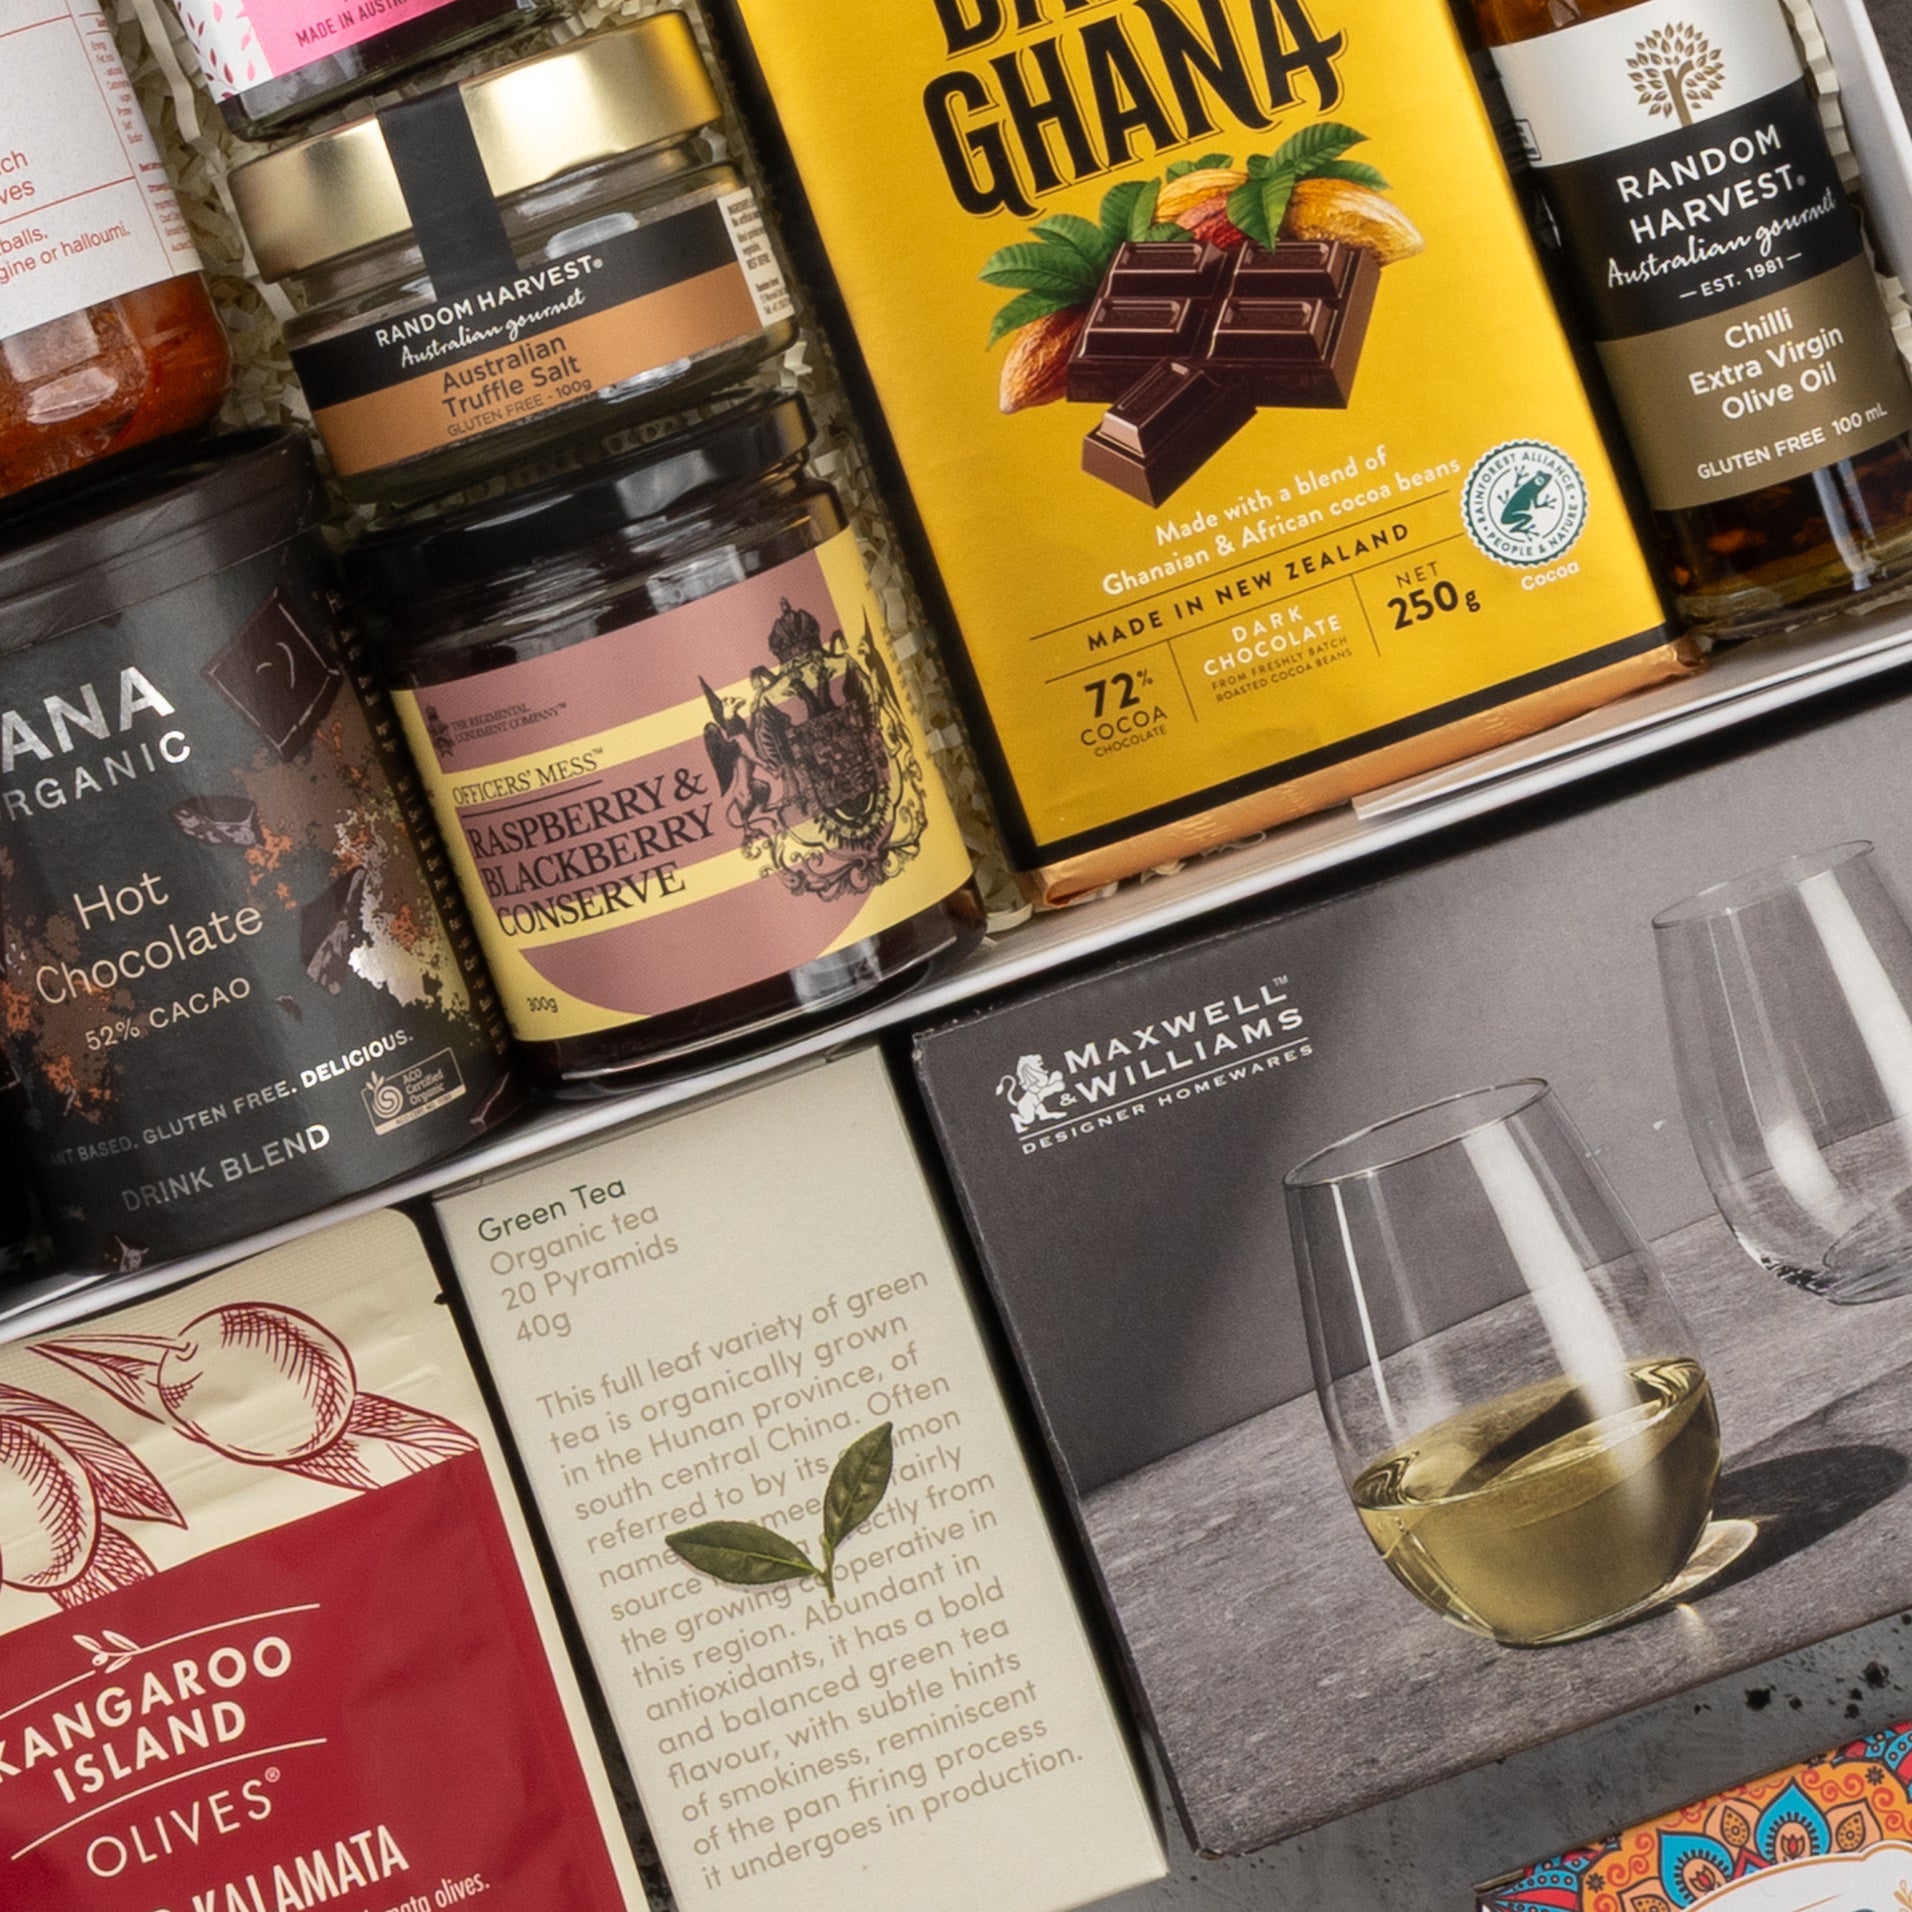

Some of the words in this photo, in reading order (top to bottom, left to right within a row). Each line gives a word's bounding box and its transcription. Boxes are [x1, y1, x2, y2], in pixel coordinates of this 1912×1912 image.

[296, 18, 337, 47] MADE
[338, 11, 355, 29] IN
[922, 0, 1348, 219] GHANA
[1617, 124, 1782, 203] RANDOM
[40, 248, 58, 265] or
[1607, 233, 1751, 289] Australian
[1755, 187, 1836, 257] gourmet
[375, 298, 474, 346] RANDOM
[400, 324, 503, 369] Australian
[505, 287, 586, 340] gourmet
[1689, 359, 1763, 396] Extra
[1766, 327, 1844, 368] Virgin
[1724, 307, 1793, 349] Chilli
[441, 371, 525, 418] Truffle
[530, 353, 581, 389] Salt
[442, 333, 567, 393] Australian
[1722, 382, 1794, 420] Olive
[1800, 361, 1838, 393] Oil
[446, 408, 503, 437] GLUTEN
[504, 393, 545, 421] FREE
[555, 377, 592, 401] 100g
[1697, 446, 1771, 480] GLUTEN
[1774, 427, 1826, 457] FREE
[1831, 411, 1863, 436] 100
[1865, 402, 1888, 423] mL
[1155, 511, 1218, 546] Made
[1224, 490, 1273, 521] with
[1279, 487, 1292, 502] a
[1294, 456, 1359, 495] blend
[1365, 444, 1388, 471] of
[1475, 453, 1516, 523] RAINFOREST
[1522, 452, 1576, 490] ALLIANCE
[1102, 550, 1210, 596] Ghanaian
[1214, 534, 1236, 557] &
[1241, 509, 1325, 549] African
[1329, 485, 1391, 516] cocoa
[1394, 459, 1461, 494] beans
[1487, 532, 1532, 556] PEOPLE
[1549, 504, 1578, 547] NATURE
[1087, 610, 1163, 651] MADE
[1174, 596, 1204, 620] IN
[1215, 571, 1273, 605] NEW
[1285, 523, 1409, 580] ZEALAND
[1395, 561, 1438, 589] NET
[1521, 560, 1580, 592] Cocoa
[1203, 614, 1343, 677] CHOCOLATE
[1211, 673, 1247, 691] FROM
[1251, 651, 1305, 678] FRESHLY
[1308, 636, 1348, 656] BATCH
[1232, 605, 1303, 643] DARK
[1083, 668, 1154, 718] 72%
[1215, 677, 1268, 703] ROASTED
[1271, 664, 1313, 684] COCOA
[1316, 649, 1353, 668] BEANS
[1, 666, 176, 774] ANA
[1079, 705, 1168, 746] COCOA
[1094, 724, 1167, 758] CHOCOLATE
[1, 730, 191, 821] RGANIC
[468, 775, 665, 859] RASPBERRY
[674, 768, 708, 802] &
[480, 803, 714, 899] BLACKBERRY
[73, 872, 170, 931] Hot
[497, 861, 686, 937] CONSERVE
[36, 906, 264, 1004] Chocolate
[85, 1017, 141, 1051] 52%
[149, 977, 250, 1029] CACAO
[77, 1136, 139, 1162] BASED.
[142, 1104, 228, 1145] GLUTEN
[233, 1080, 297, 1115] FREE.
[300, 1029, 414, 1089] DELICIOUS.
[1060, 1093, 1077, 1108] &
[1075, 1007, 1304, 1104] WILLIAMS
[1021, 1103, 1147, 1155] DESIGNER
[1158, 1044, 1314, 1108] HOMEWARES
[122, 1166, 213, 1212] DRINK
[220, 1124, 330, 1183] BLEND
[477, 1200, 567, 1242] Green
[570, 1179, 626, 1210] Tea
[490, 1222, 606, 1276] Organic
[611, 1205, 660, 1234] tea
[501, 1281, 537, 1312] 20
[543, 1234, 678, 1296] Pyramids
[516, 1311, 572, 1343] 40g
[535, 1385, 596, 1419] This
[600, 1363, 644, 1399] full
[648, 1341, 702, 1383] leaf
[708, 1313, 802, 1360] variety
[812, 1293, 838, 1324] of
[846, 1271, 929, 1319] green
[550, 1424, 600, 1453] tea
[605, 1411, 631, 1434] is
[640, 1350, 802, 1422] organically
[814, 1315, 909, 1368] grown
[560, 1464, 589, 1487] in
[595, 1447, 642, 1476] the
[648, 1411, 745, 1457] Hunan
[752, 1364, 883, 1428] province,
[891, 1340, 918, 1372] of
[575, 1476, 652, 1521] south
[661, 1435, 760, 1490] central
[767, 1409, 861, 1452] China.
[867, 1375, 951, 1417] Often
[586, 1491, 707, 1554] referred
[714, 1486, 744, 1509] to
[750, 1470, 786, 1497] by
[793, 1456, 829, 1482] its
[611, 1576, 703, 1622] source
[926, 1474, 995, 1509] from
[620, 1626, 667, 1655] the
[675, 1584, 792, 1643] growing
[800, 1526, 964, 1593] cooperative
[970, 1509, 997, 1532] in
[632, 1656, 685, 1688] this
[693, 1622, 796, 1669] region.
[805, 1561, 946, 1631] Abundant
[952, 1553, 981, 1576] in
[646, 1650, 824, 1722] antioxidants,
[828, 1635, 848, 1658] it
[854, 1618, 908, 1650] has
[915, 1609, 935, 1628] a
[938, 1576, 1005, 1619] bold
[658, 1716, 714, 1755] and
[720, 1665, 860, 1733] balanced
[868, 1639, 954, 1690] green
[960, 1618, 1010, 1649] tea
[668, 1739, 779, 1789] flavour,
[786, 1711, 849, 1748] with
[857, 1679, 944, 1724] subtle
[950, 1652, 1022, 1691] hints
[53, 1700, 247, 1804] ISLAND
[681, 1791, 710, 1822] of
[718, 1747, 871, 1810] smokiness,
[876, 1680, 1037, 1756] reminiscent
[694, 1825, 721, 1856] of
[727, 1816, 776, 1845] the
[783, 1793, 841, 1833] pan
[847, 1762, 928, 1803] firing
[935, 1719, 1048, 1780] process
[701, 1866, 722, 1890] it
[730, 1816, 883, 1881] undergoes
[886, 1803, 915, 1827] in
[921, 1747, 1084, 1823] production.
[434, 1873, 490, 1908] olives.
